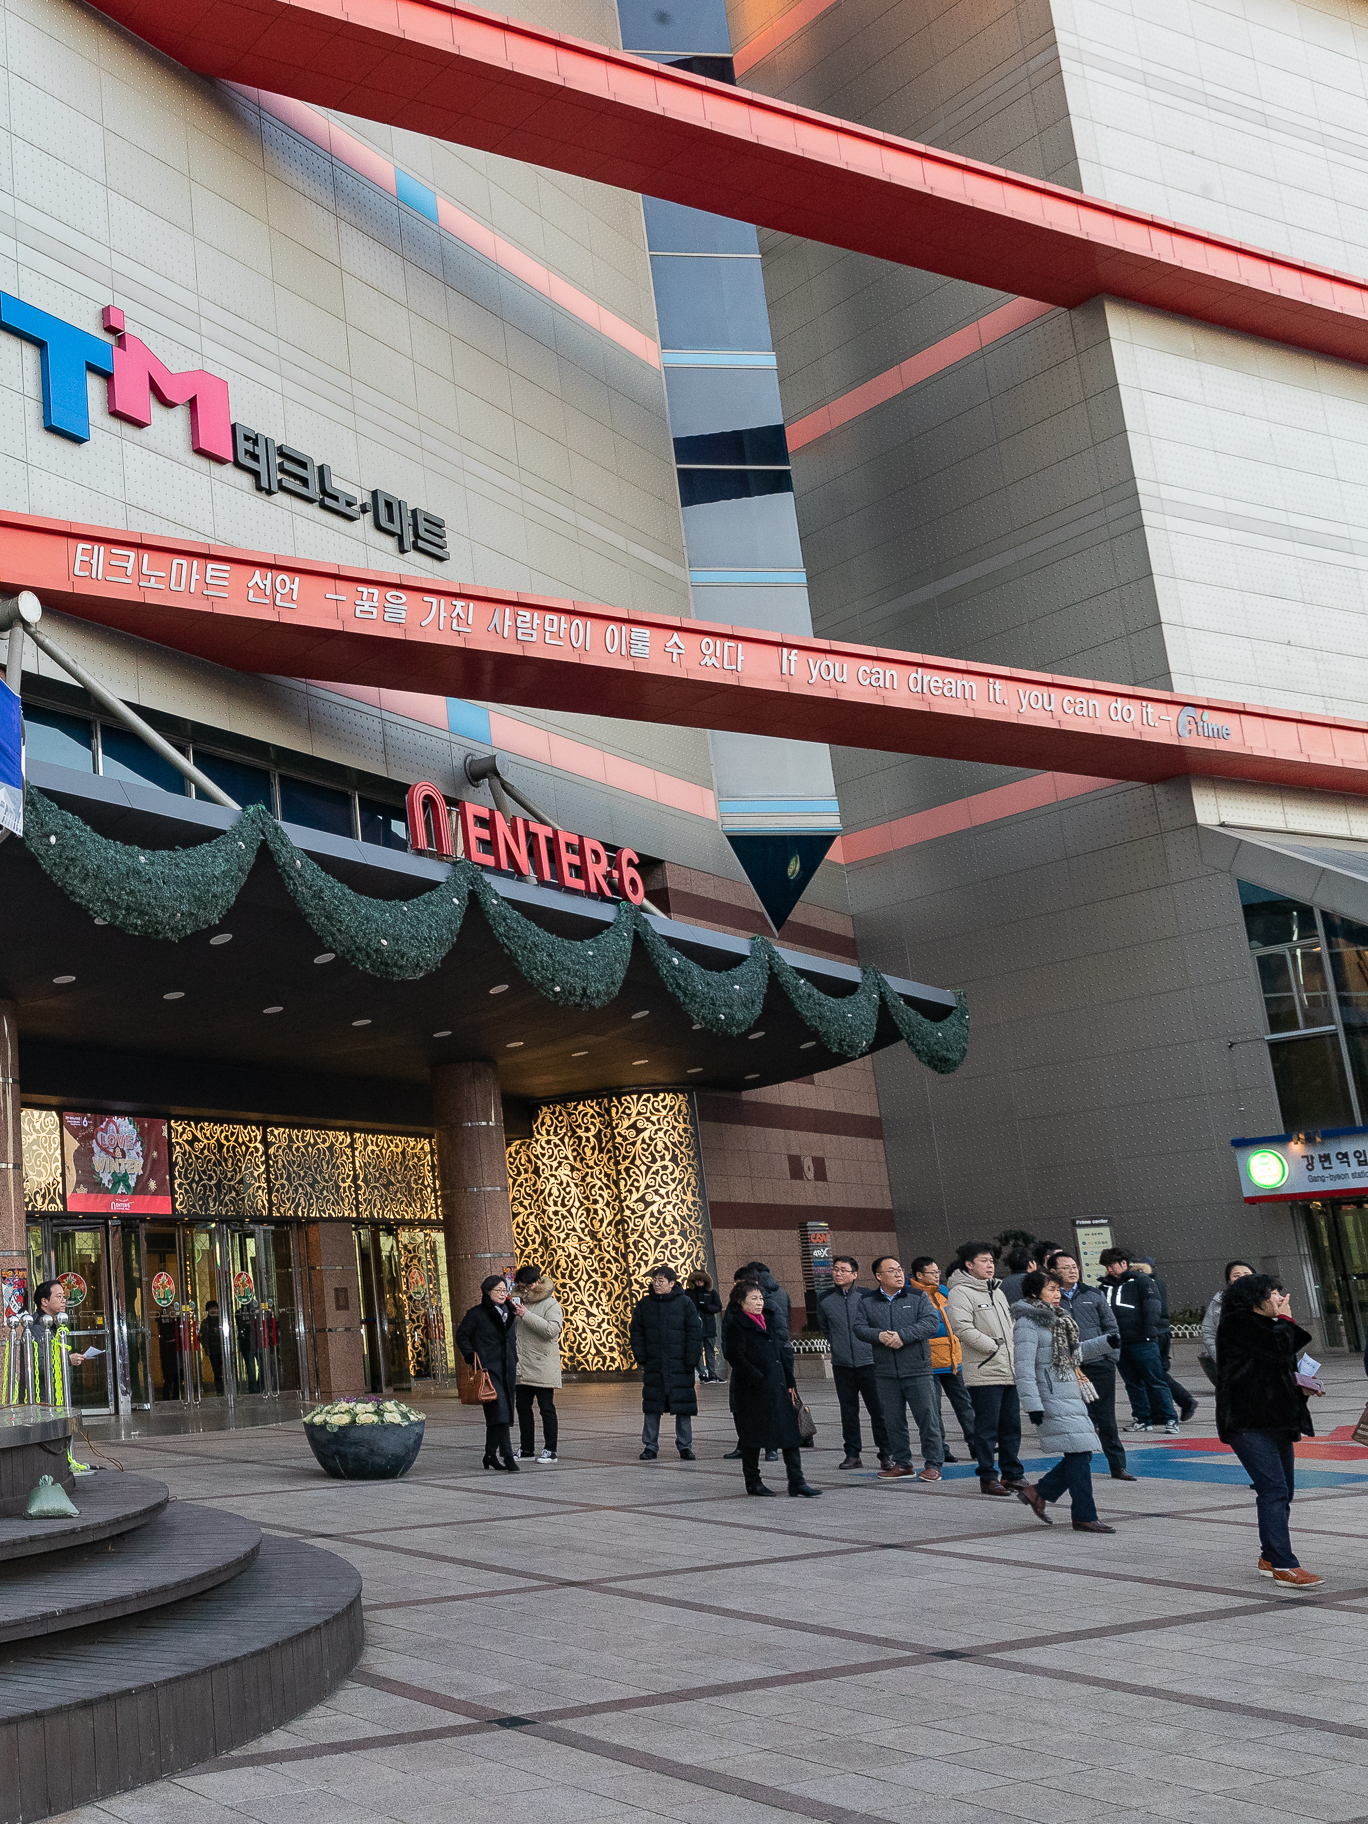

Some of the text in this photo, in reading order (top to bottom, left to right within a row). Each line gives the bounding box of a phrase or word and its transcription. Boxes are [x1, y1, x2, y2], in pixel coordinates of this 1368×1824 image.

[73, 543, 231, 598] 테크노마트
[247, 569, 299, 609] 선언
[354, 586, 408, 624] 꿈을
[420, 596, 474, 634] 가진
[487, 607, 591, 652] 사람만이
[605, 624, 650, 659] 이룰
[664, 632, 685, 663] 수
[700, 637, 744, 672] 있다
[781, 647, 798, 676] If
[807, 656, 848, 685] you
[857, 665, 898, 691] can
[908, 667, 977, 702] dream
[1017, 686, 1055, 713] you
[1061, 694, 1099, 719] can
[1109, 696, 1136, 724] do
[100, 1132, 134, 1150] LOVE
[92, 1156, 143, 1175] WINTER
